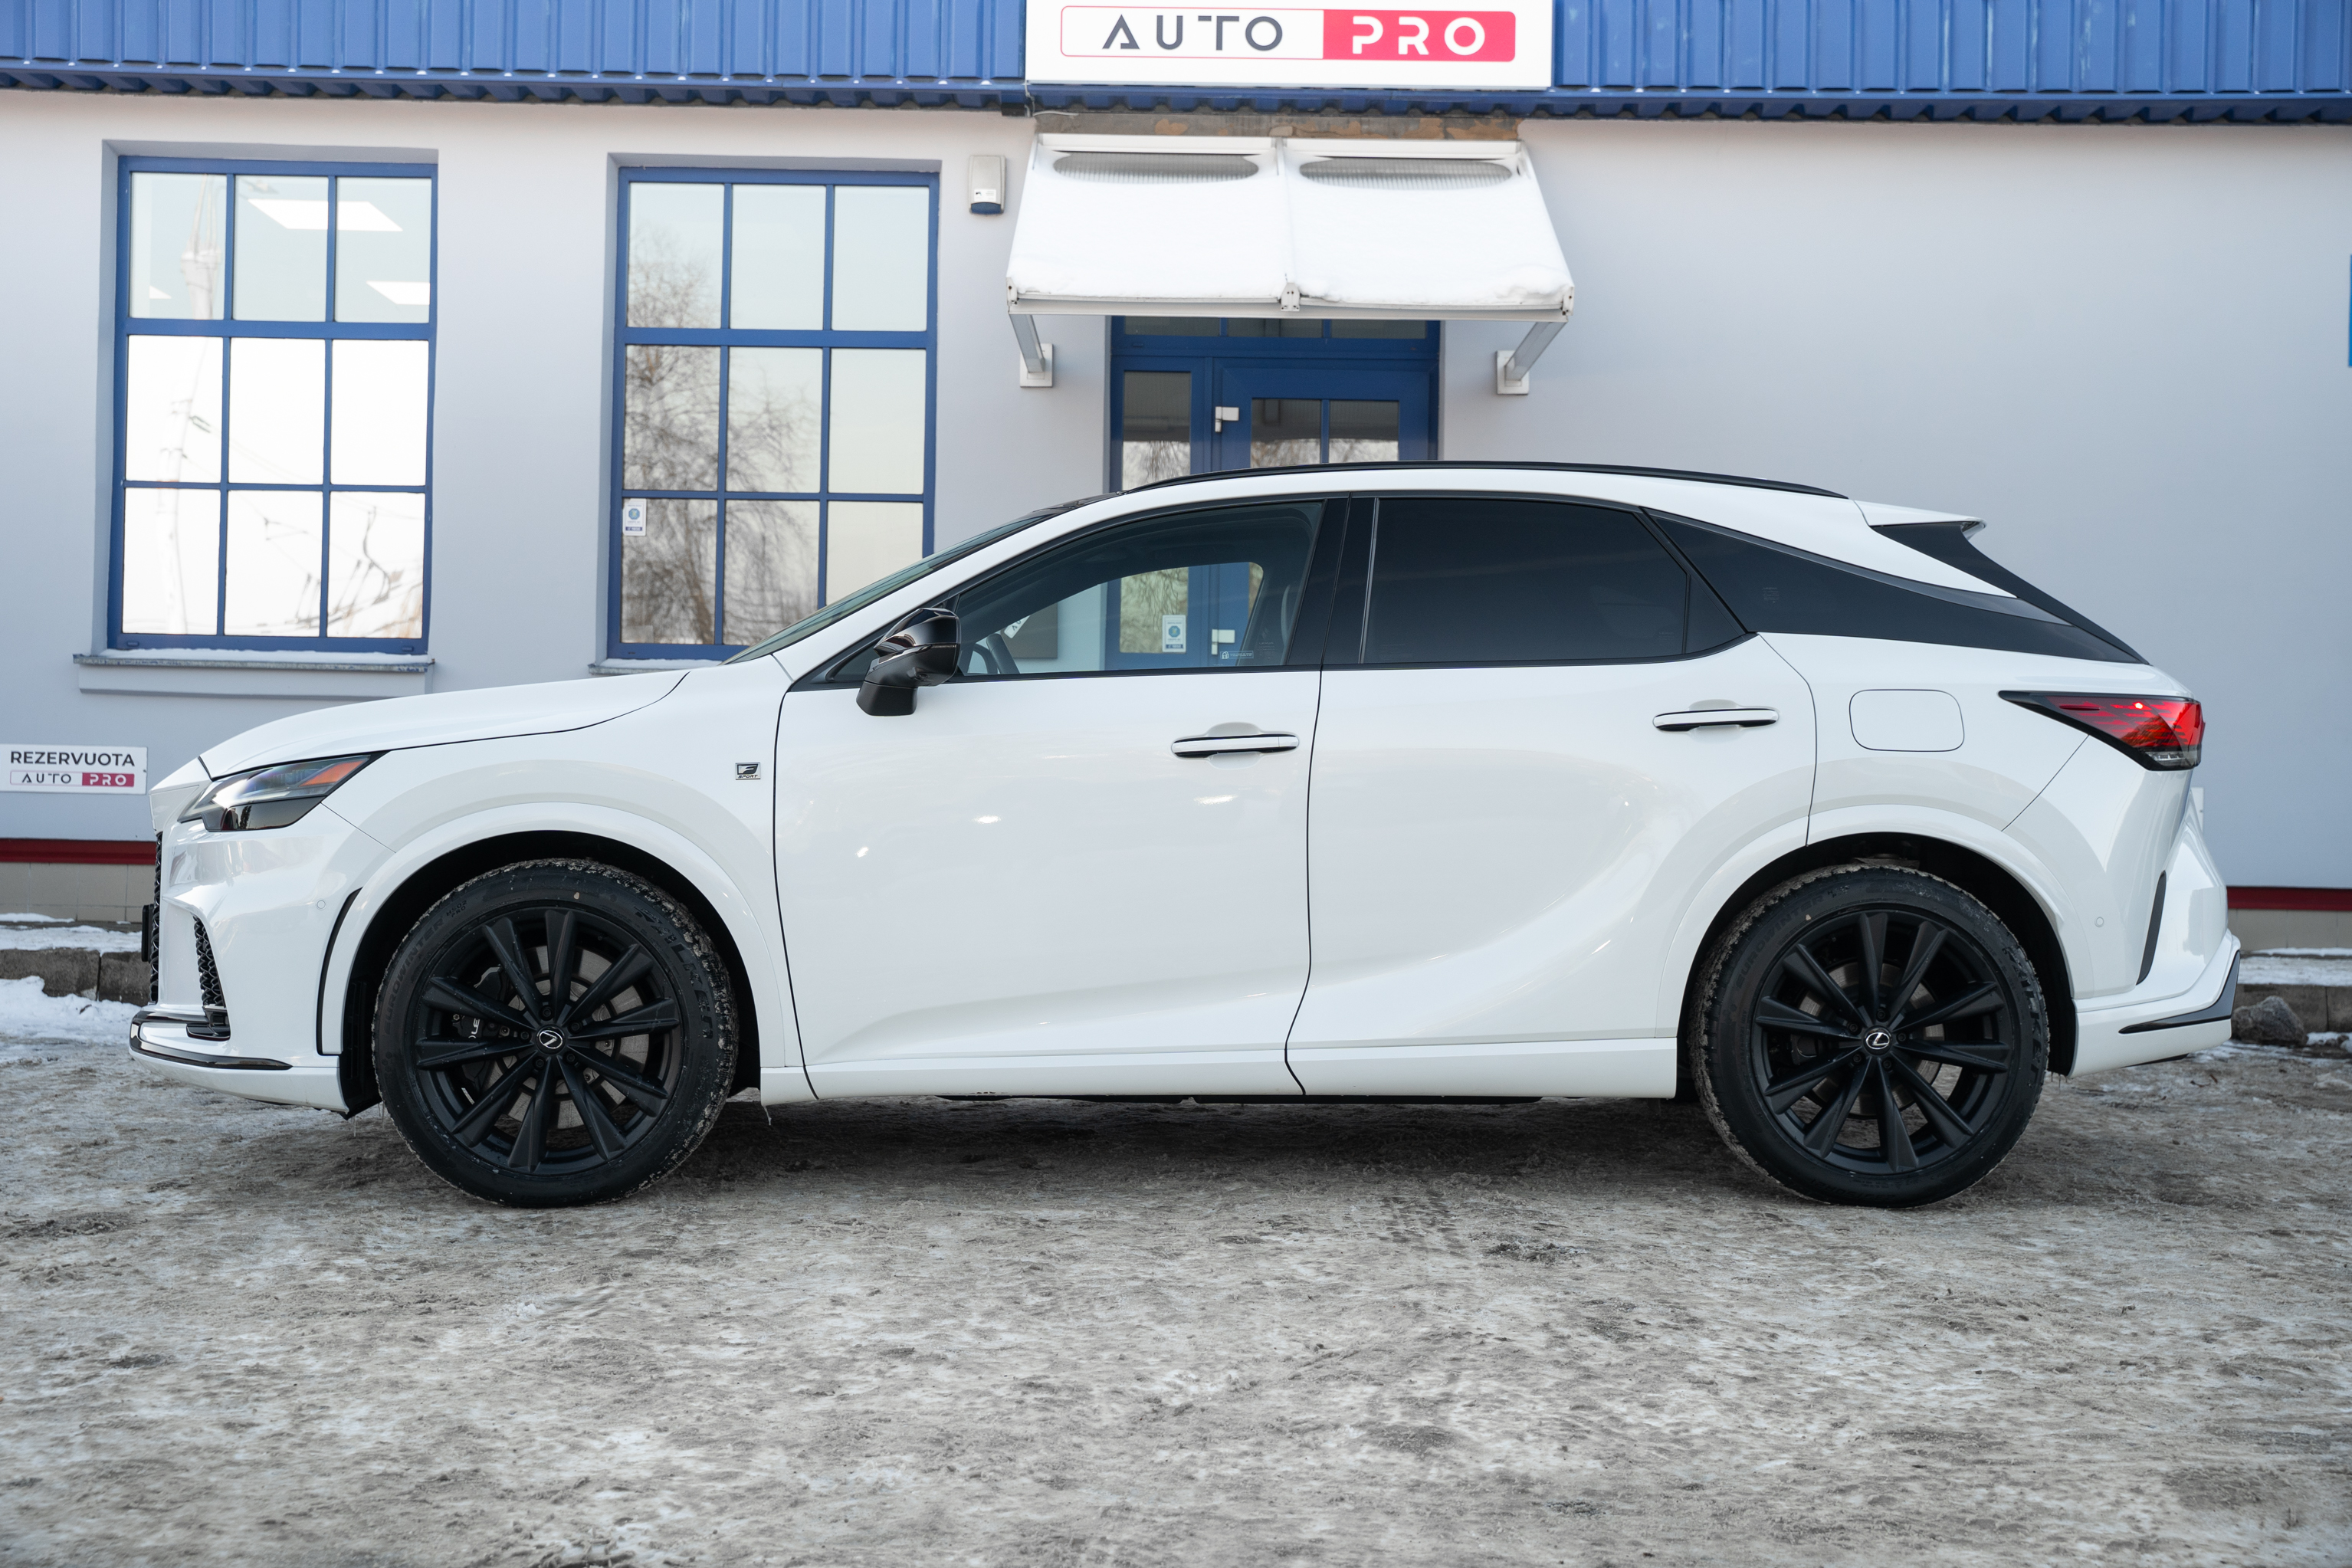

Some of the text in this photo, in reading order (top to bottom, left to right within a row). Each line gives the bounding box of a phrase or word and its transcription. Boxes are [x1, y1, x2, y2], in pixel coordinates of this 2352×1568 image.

[1101, 13, 1487, 56] AUTO PRO
[10, 750, 136, 767] REZERVUOTA
[21, 773, 127, 786] AUTO PRO
[1735, 894, 1825, 990] EUROWINTER
[382, 918, 446, 1035] EUROWINTER
